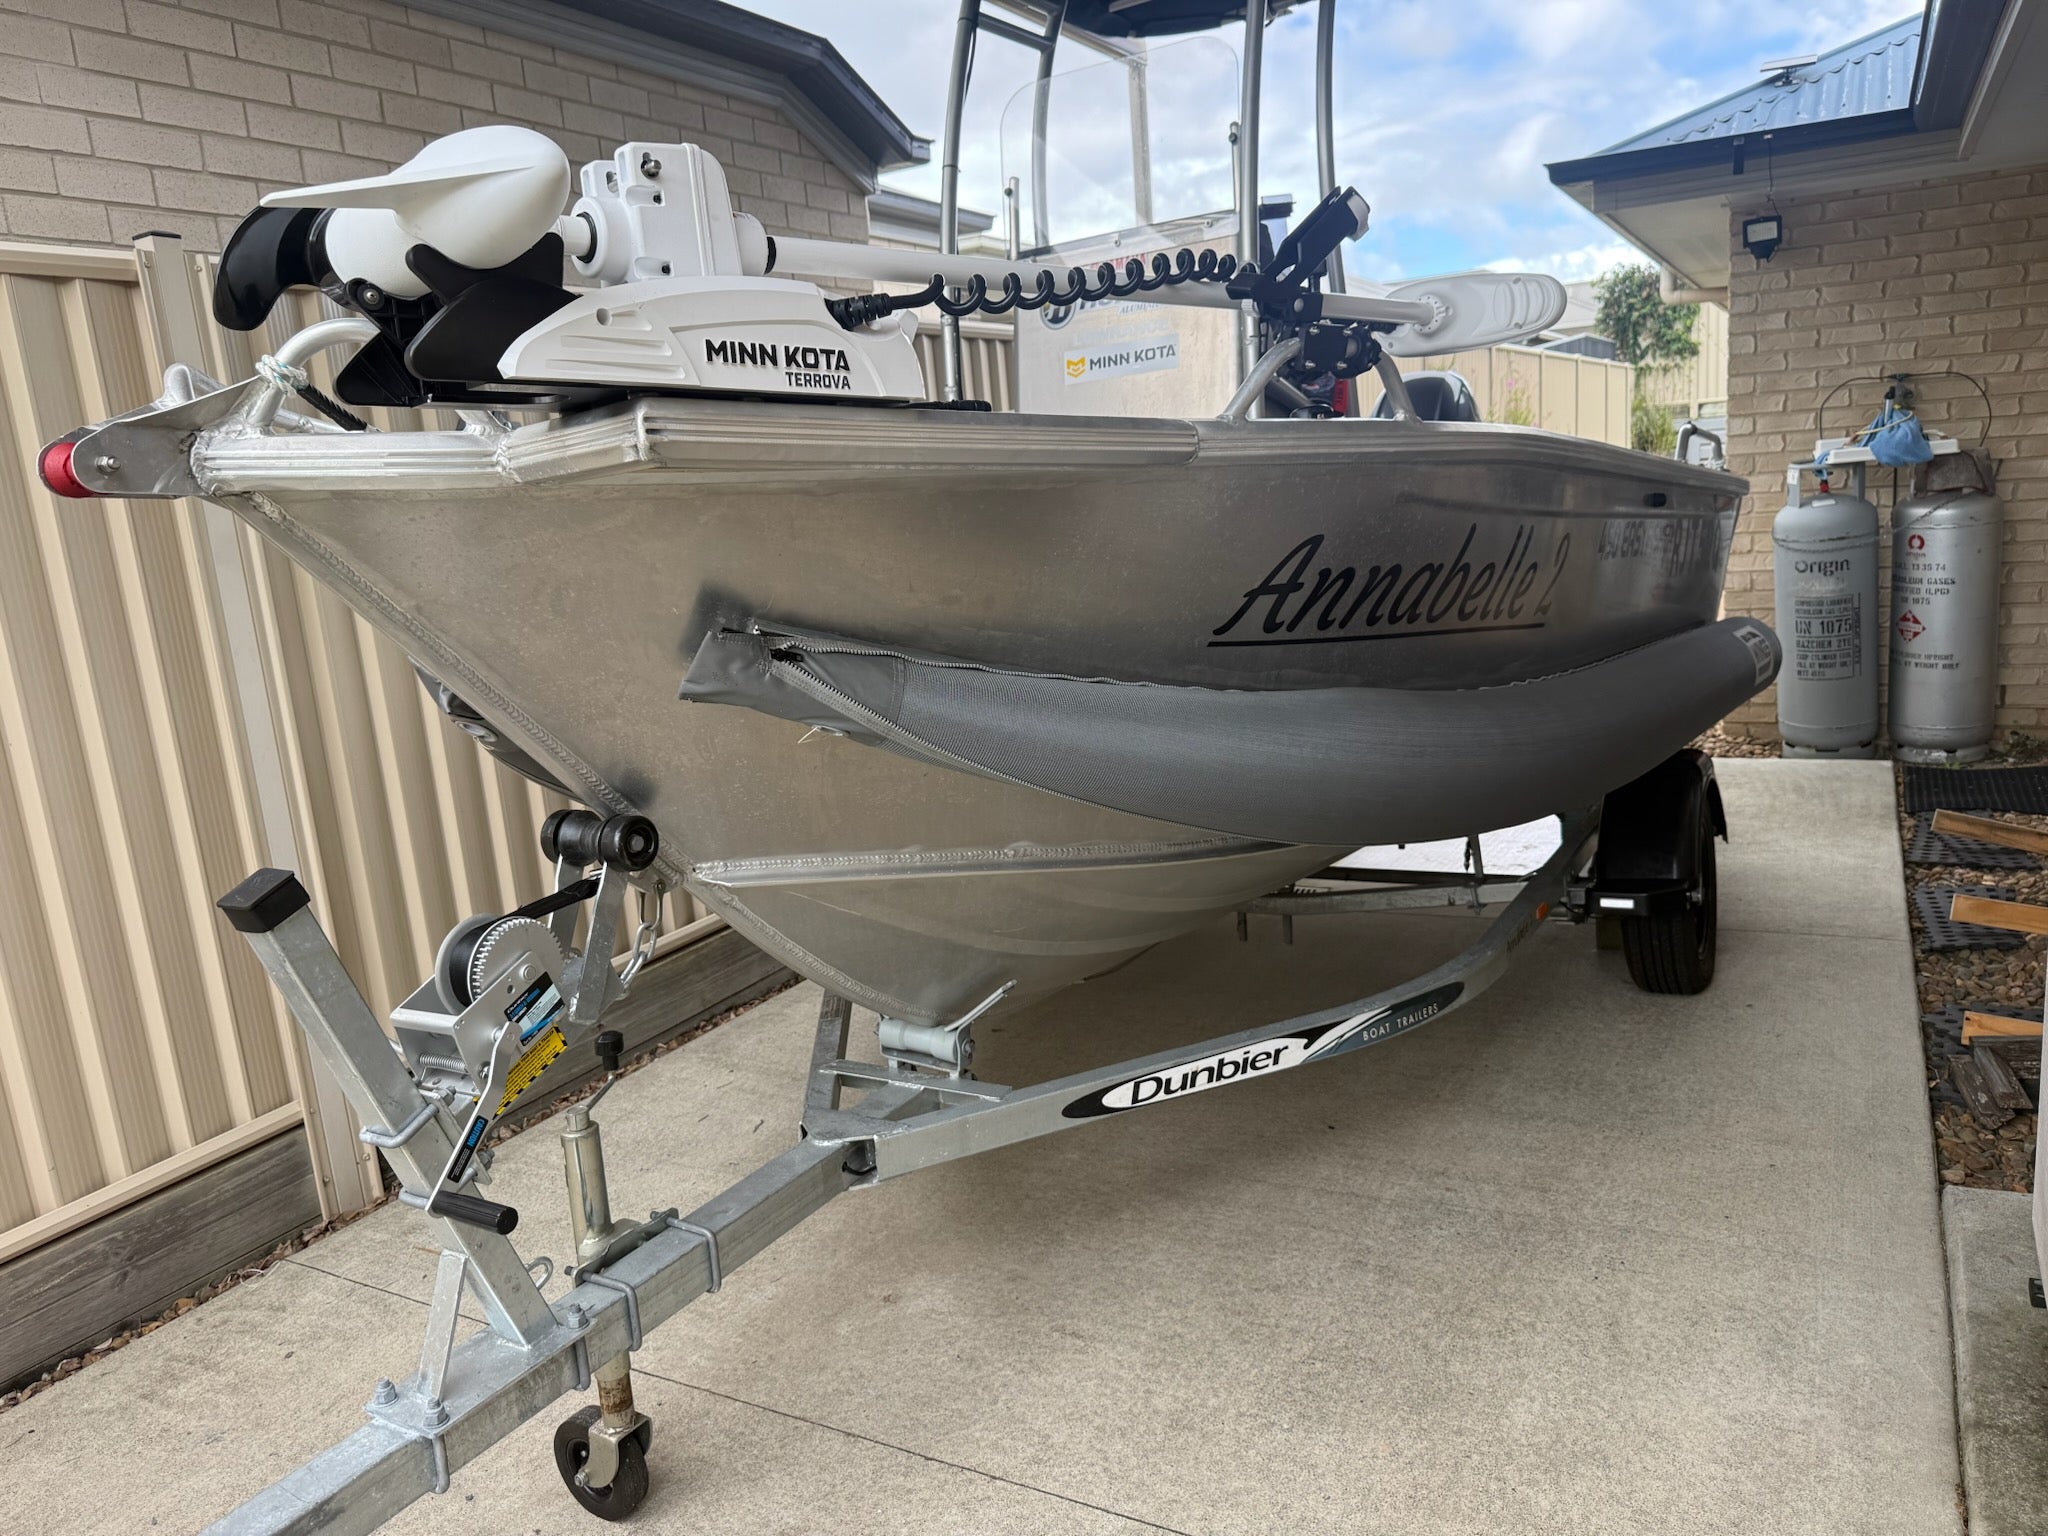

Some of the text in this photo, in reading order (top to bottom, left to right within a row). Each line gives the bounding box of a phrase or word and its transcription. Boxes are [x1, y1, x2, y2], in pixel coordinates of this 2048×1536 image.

[705, 338, 850, 372] MINN KOTA
[1089, 344, 1176, 371] MINN KOTA
[785, 371, 851, 390] TERROVA
[1212, 522, 1540, 636] Annabelle
[1537, 531, 1571, 617] 2
[1794, 558, 1851, 577] Origin
[1795, 617, 1852, 635] UN 1075
[1362, 1003, 1439, 1041] BOAT TRAILERS
[1131, 1044, 1289, 1105] Dunbier
[467, 1118, 485, 1148] CAUTION
